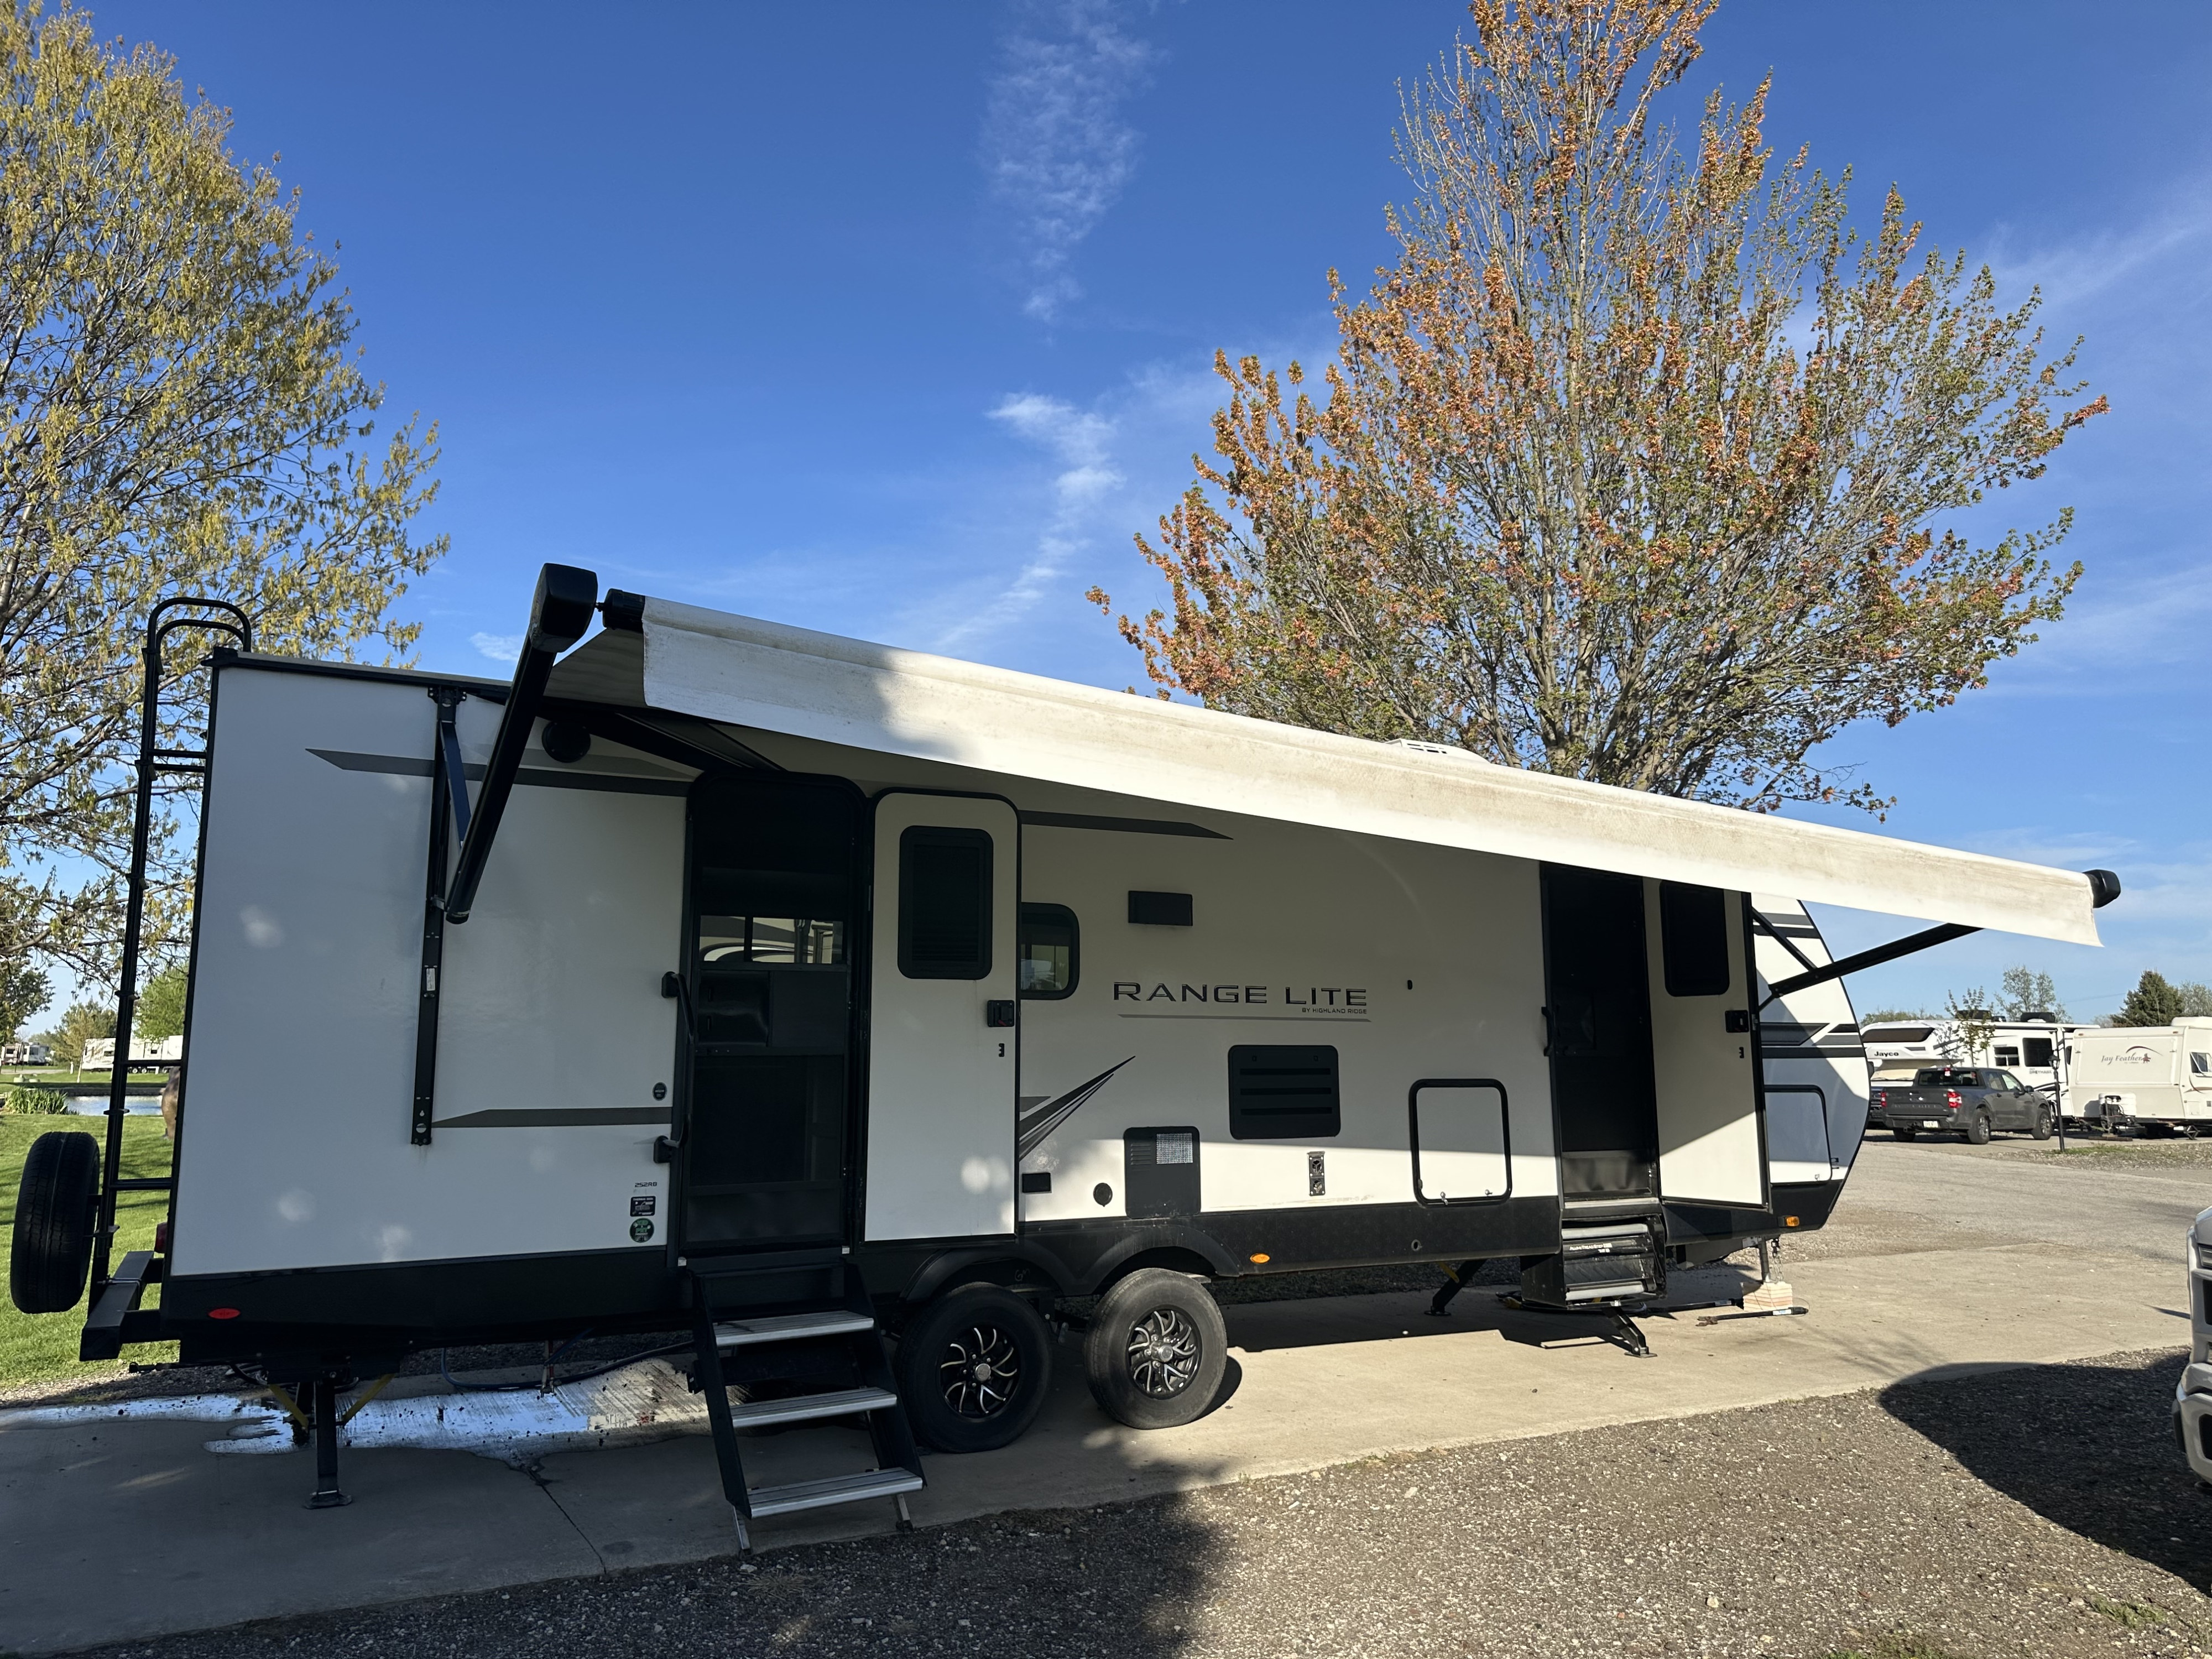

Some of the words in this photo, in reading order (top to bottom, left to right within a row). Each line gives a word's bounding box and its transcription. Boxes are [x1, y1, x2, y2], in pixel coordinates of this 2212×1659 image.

[1113, 982, 1267, 1004] RANGE
[1285, 987, 1367, 1006] LITE
[2101, 1055, 2113, 1065] Jay
[2115, 1052, 2142, 1061] Feather
